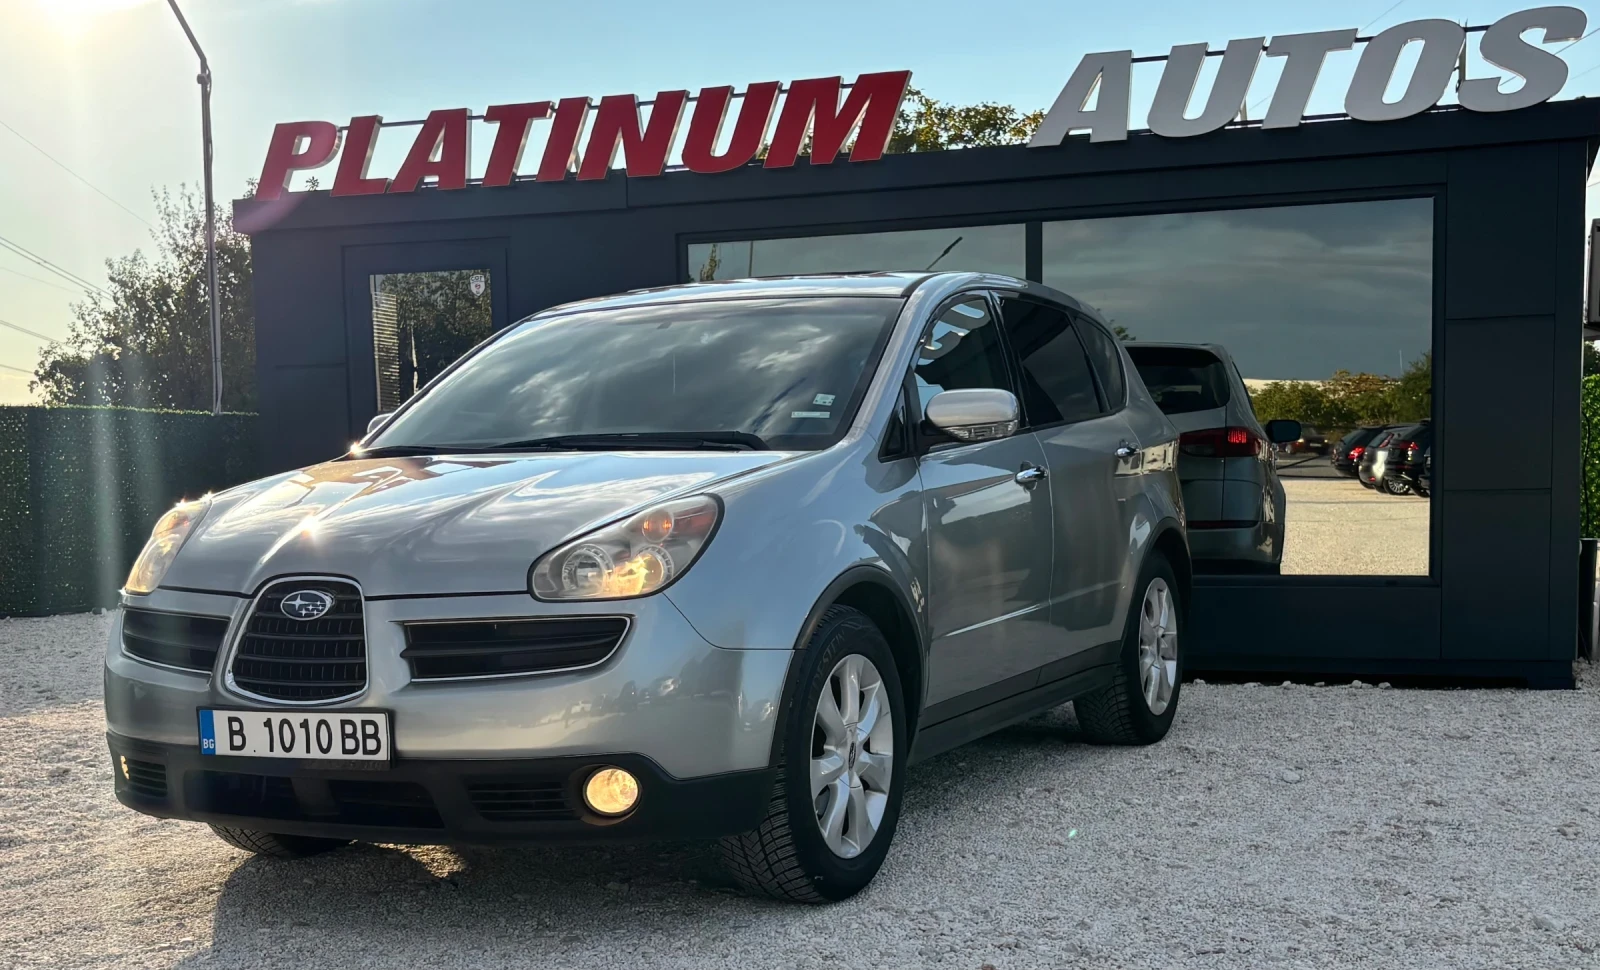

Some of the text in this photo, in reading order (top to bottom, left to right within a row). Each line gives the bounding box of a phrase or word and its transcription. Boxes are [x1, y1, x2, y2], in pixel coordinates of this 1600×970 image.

[256, 5, 1588, 201] PLATINUM AUTOS
[202, 738, 215, 749] BG
[263, 717, 333, 754] 1010
[340, 719, 382, 756] BB
